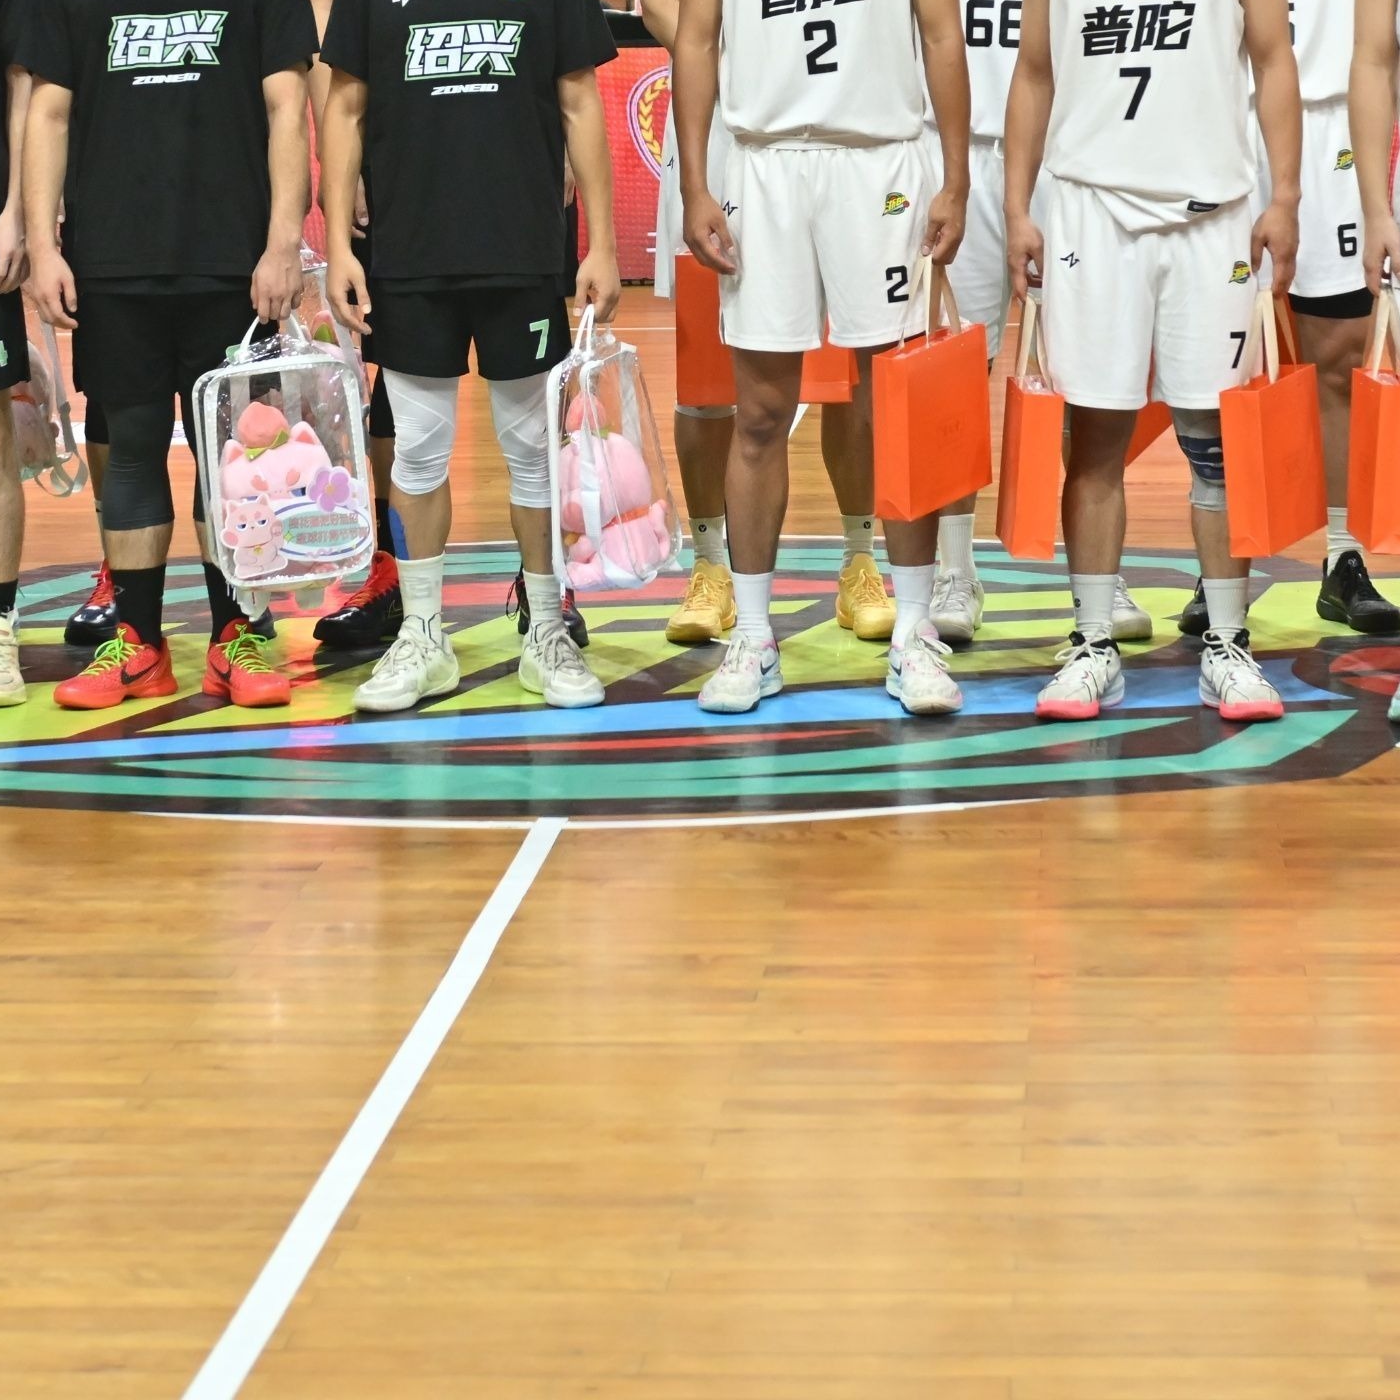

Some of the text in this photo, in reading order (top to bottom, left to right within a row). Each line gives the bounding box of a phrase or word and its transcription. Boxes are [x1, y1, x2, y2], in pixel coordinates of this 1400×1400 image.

[107, 9, 228, 71] 绍兴
[405, 21, 525, 80] 绍兴
[803, 19, 838, 75] 2
[1081, 1, 1196, 56] 普陀
[1119, 67, 1152, 120] 7
[1337, 223, 1357, 257] 6
[885, 265, 910, 303] 2
[529, 319, 550, 360] 7
[1230, 331, 1247, 369] 7
